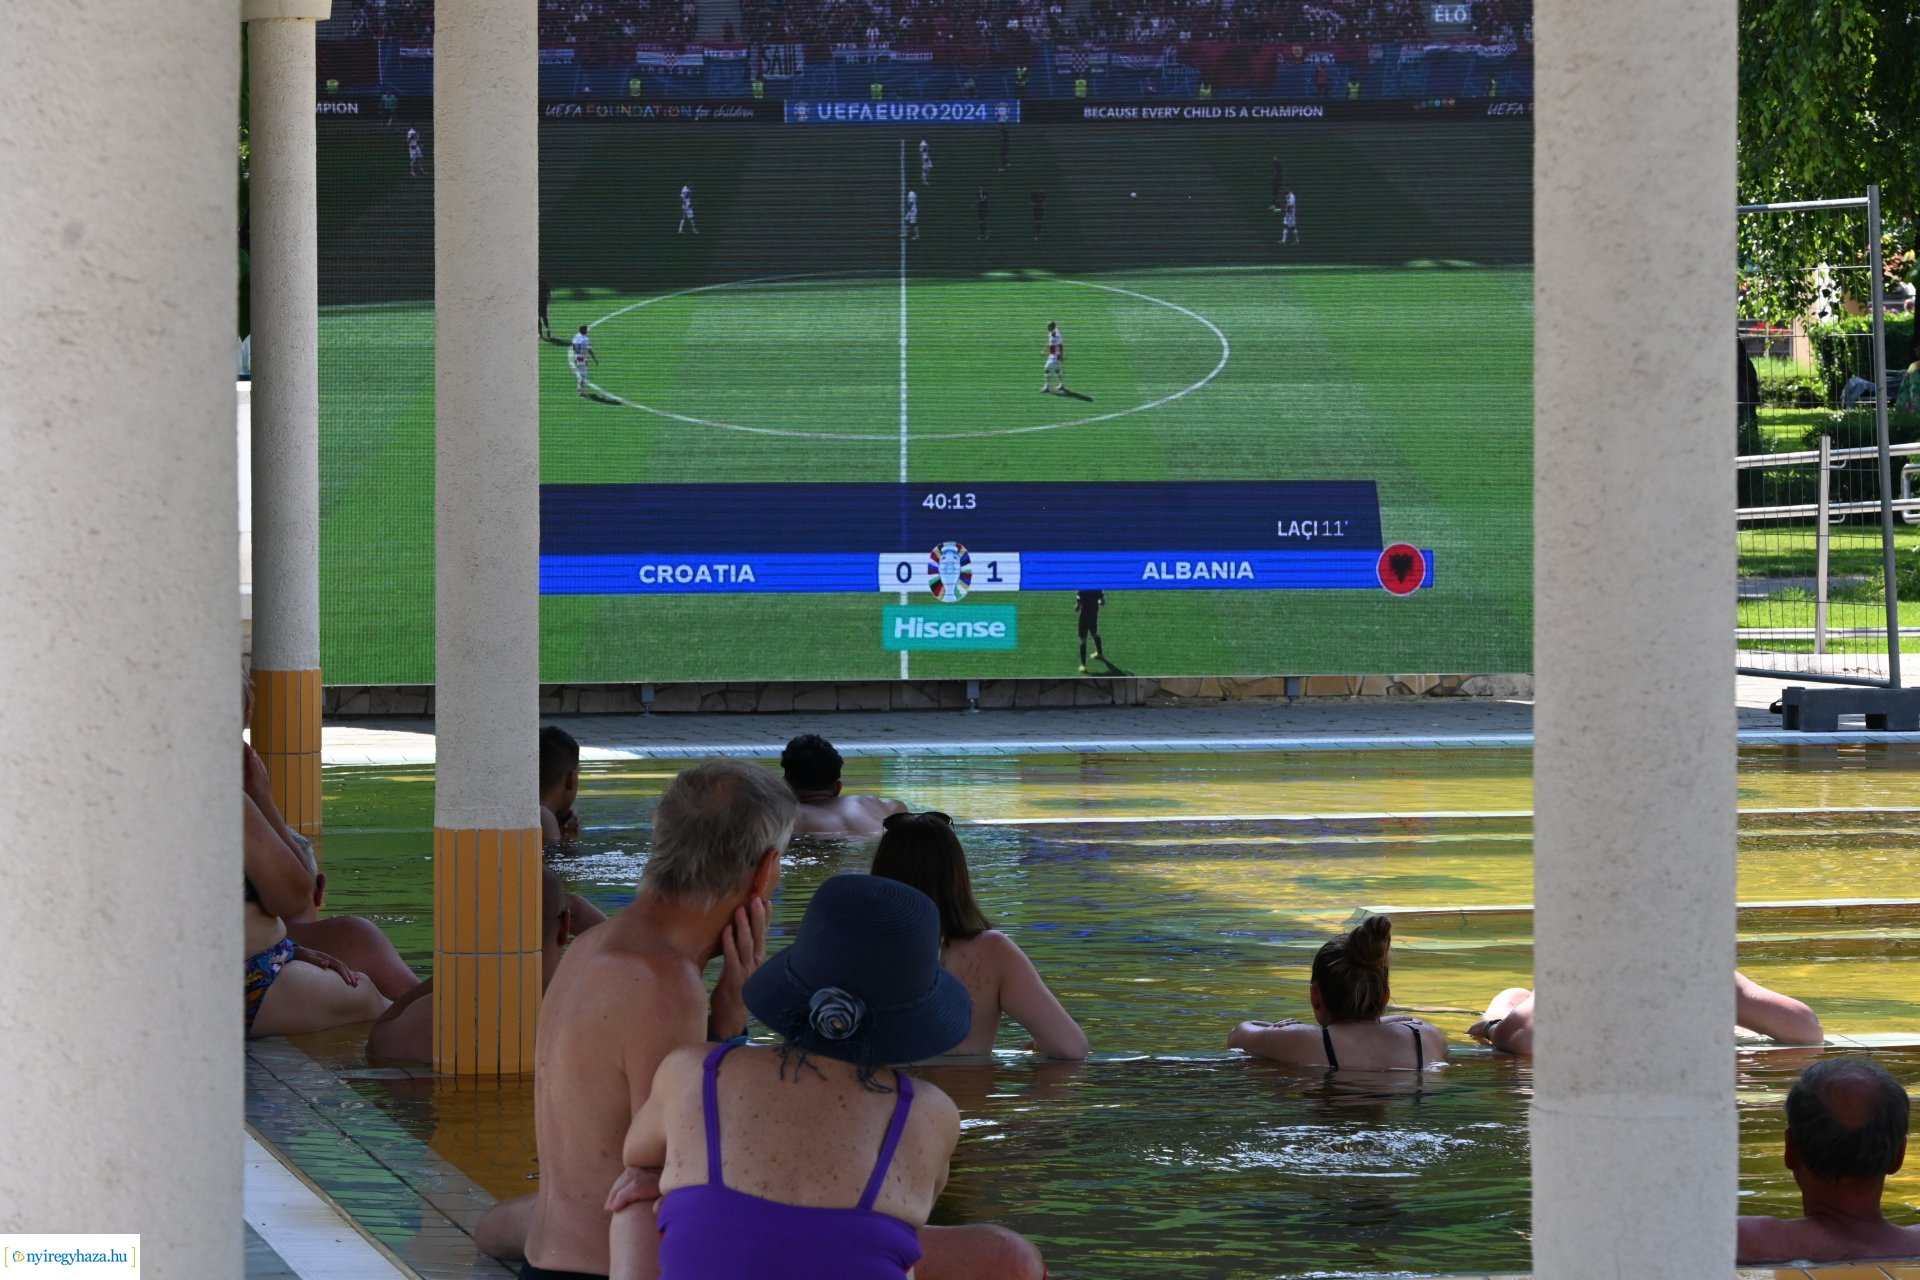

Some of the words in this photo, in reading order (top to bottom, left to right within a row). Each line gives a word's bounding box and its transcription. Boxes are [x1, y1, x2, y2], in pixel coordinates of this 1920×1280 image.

[1084, 106, 1139, 118] BECAUSE
[1142, 107, 1180, 118] EVERY
[1183, 106, 1221, 118] CHILD
[1225, 106, 1236, 117] IS
[1239, 106, 1248, 117] A
[1252, 105, 1323, 118] CHAMPION
[1487, 102, 1524, 115] UEFA
[922, 493, 976, 510] 40:13
[1277, 519, 1318, 540] LAÇI
[639, 564, 755, 583] CROATIA
[896, 562, 912, 582] 0
[987, 562, 1003, 582] 1
[1142, 562, 1254, 580] ALBANIA
[894, 616, 1006, 639] Hisense
